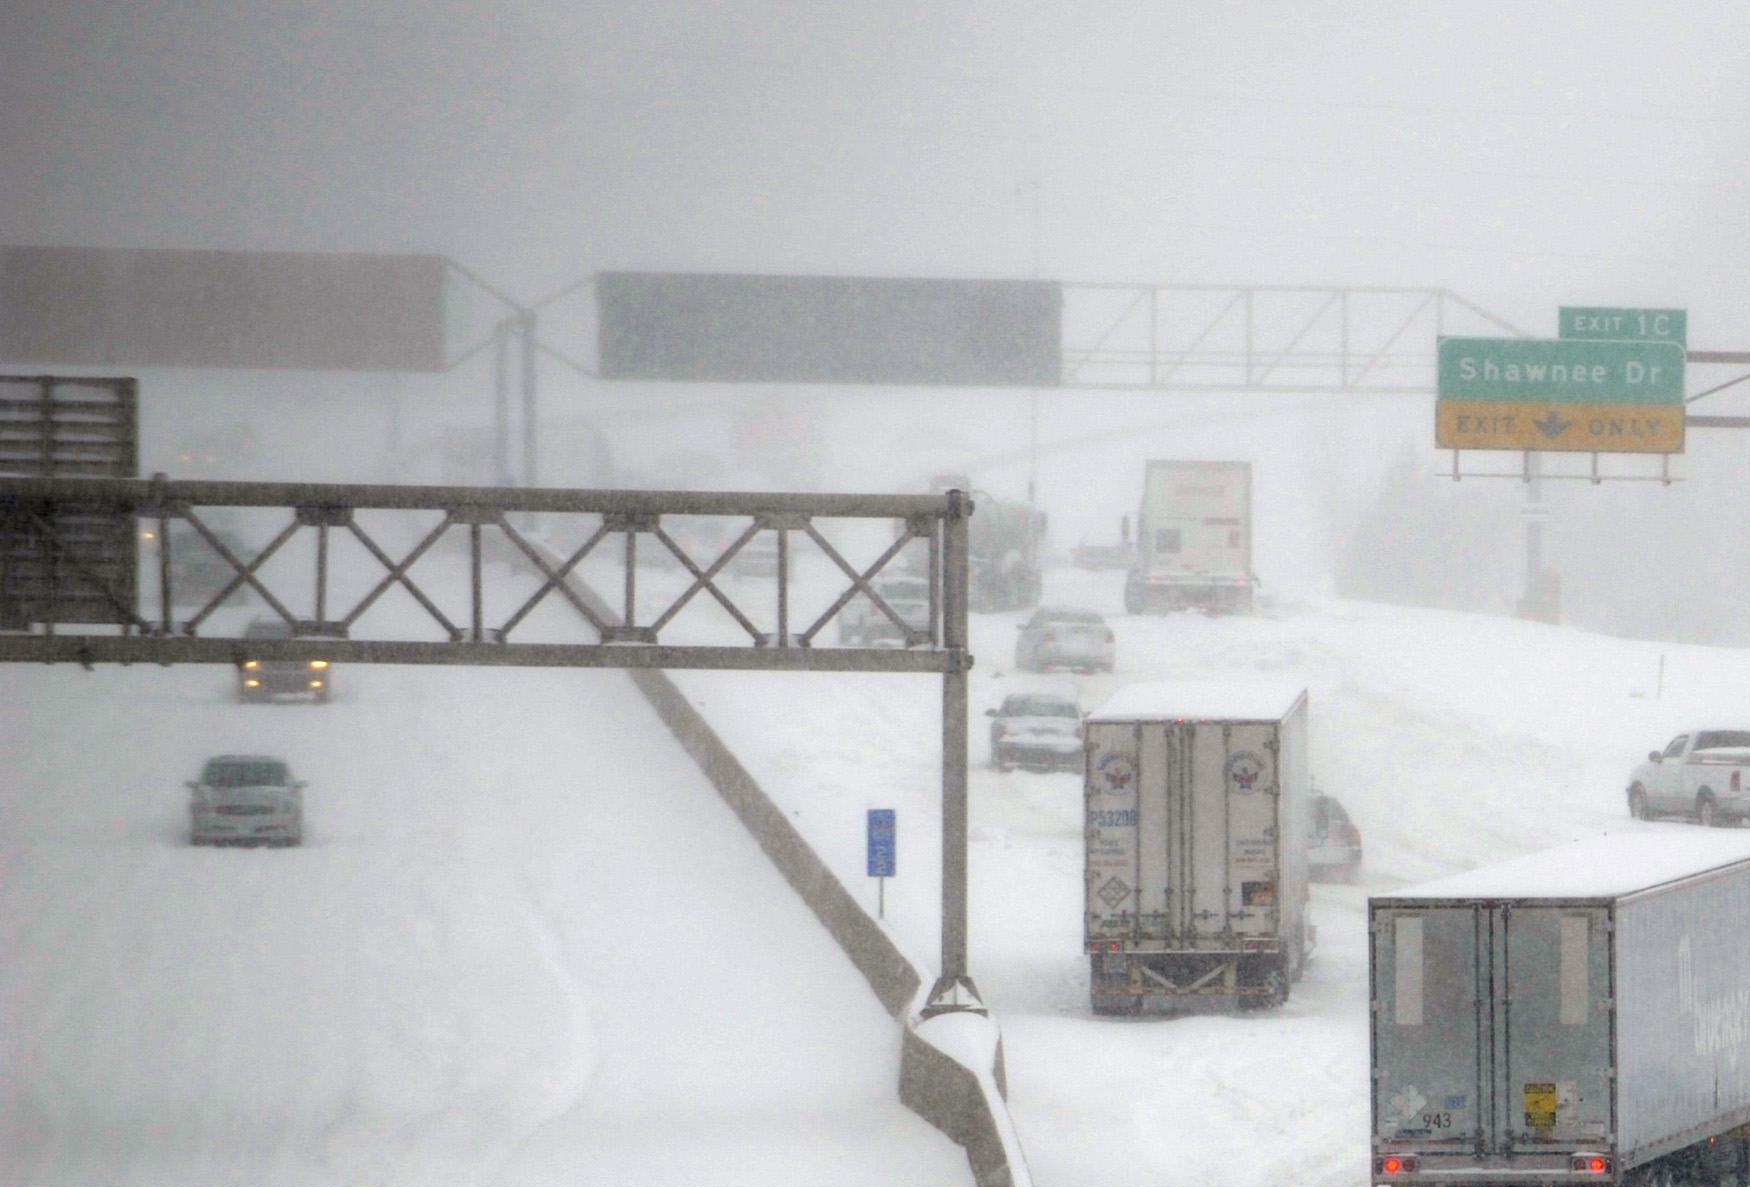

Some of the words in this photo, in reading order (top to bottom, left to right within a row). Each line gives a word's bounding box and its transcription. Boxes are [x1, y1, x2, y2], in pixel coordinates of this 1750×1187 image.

[1574, 315, 1625, 331] EXIT
[1637, 315, 1670, 337] 1C
[1459, 356, 1608, 383] Shawnee
[1625, 360, 1663, 385] Dr
[1456, 414, 1517, 434] EXIT
[1587, 417, 1661, 436] ONLY
[1422, 1112, 1452, 1129] 943
